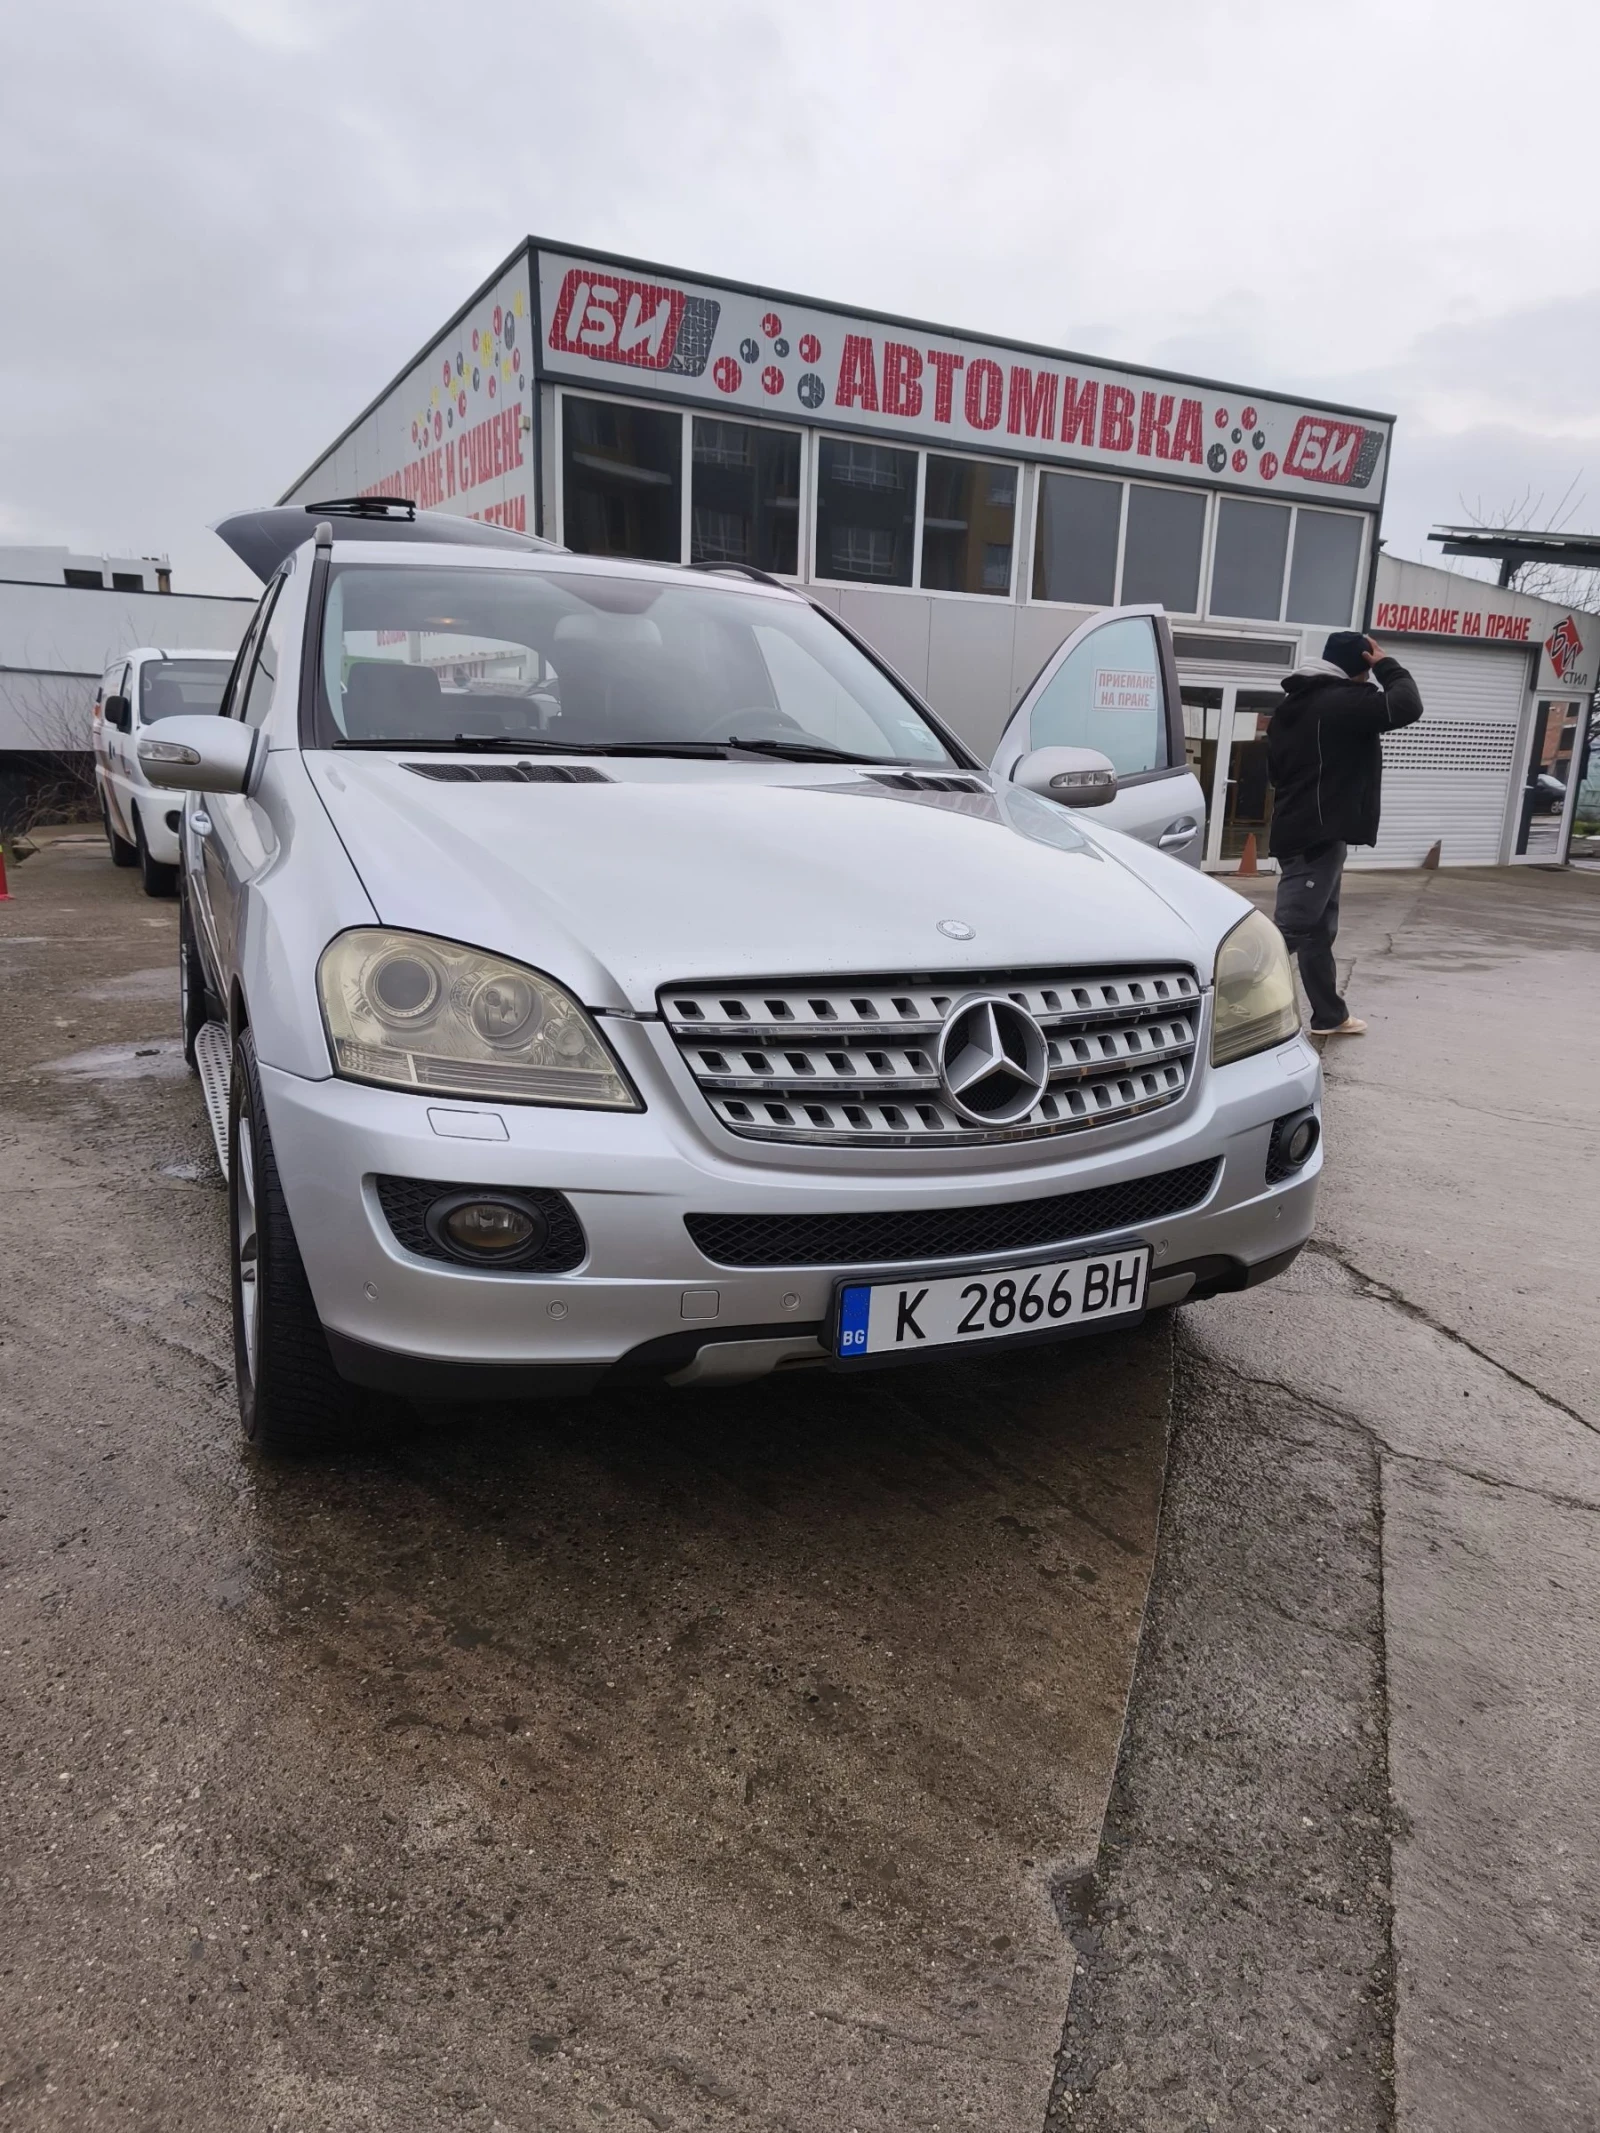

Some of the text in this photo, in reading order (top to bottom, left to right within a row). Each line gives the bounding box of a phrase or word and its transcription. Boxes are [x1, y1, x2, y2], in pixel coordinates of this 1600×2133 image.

[835, 333, 1203, 464] АВТОМИВКА
[445, 440, 456, 498] И
[459, 402, 523, 492] СУШЕНЕ
[1376, 602, 1532, 641] ИЗДАВАНЕ НА ПРАНЕ
[1098, 672, 1155, 689] ПРИЕМАНЕ
[1563, 671, 1587, 686] СТИЛ
[1101, 691, 1150, 707] НА ПРАНЕ
[895, 1256, 1141, 1342] K 2866 BH
[842, 1330, 865, 1346] BG
